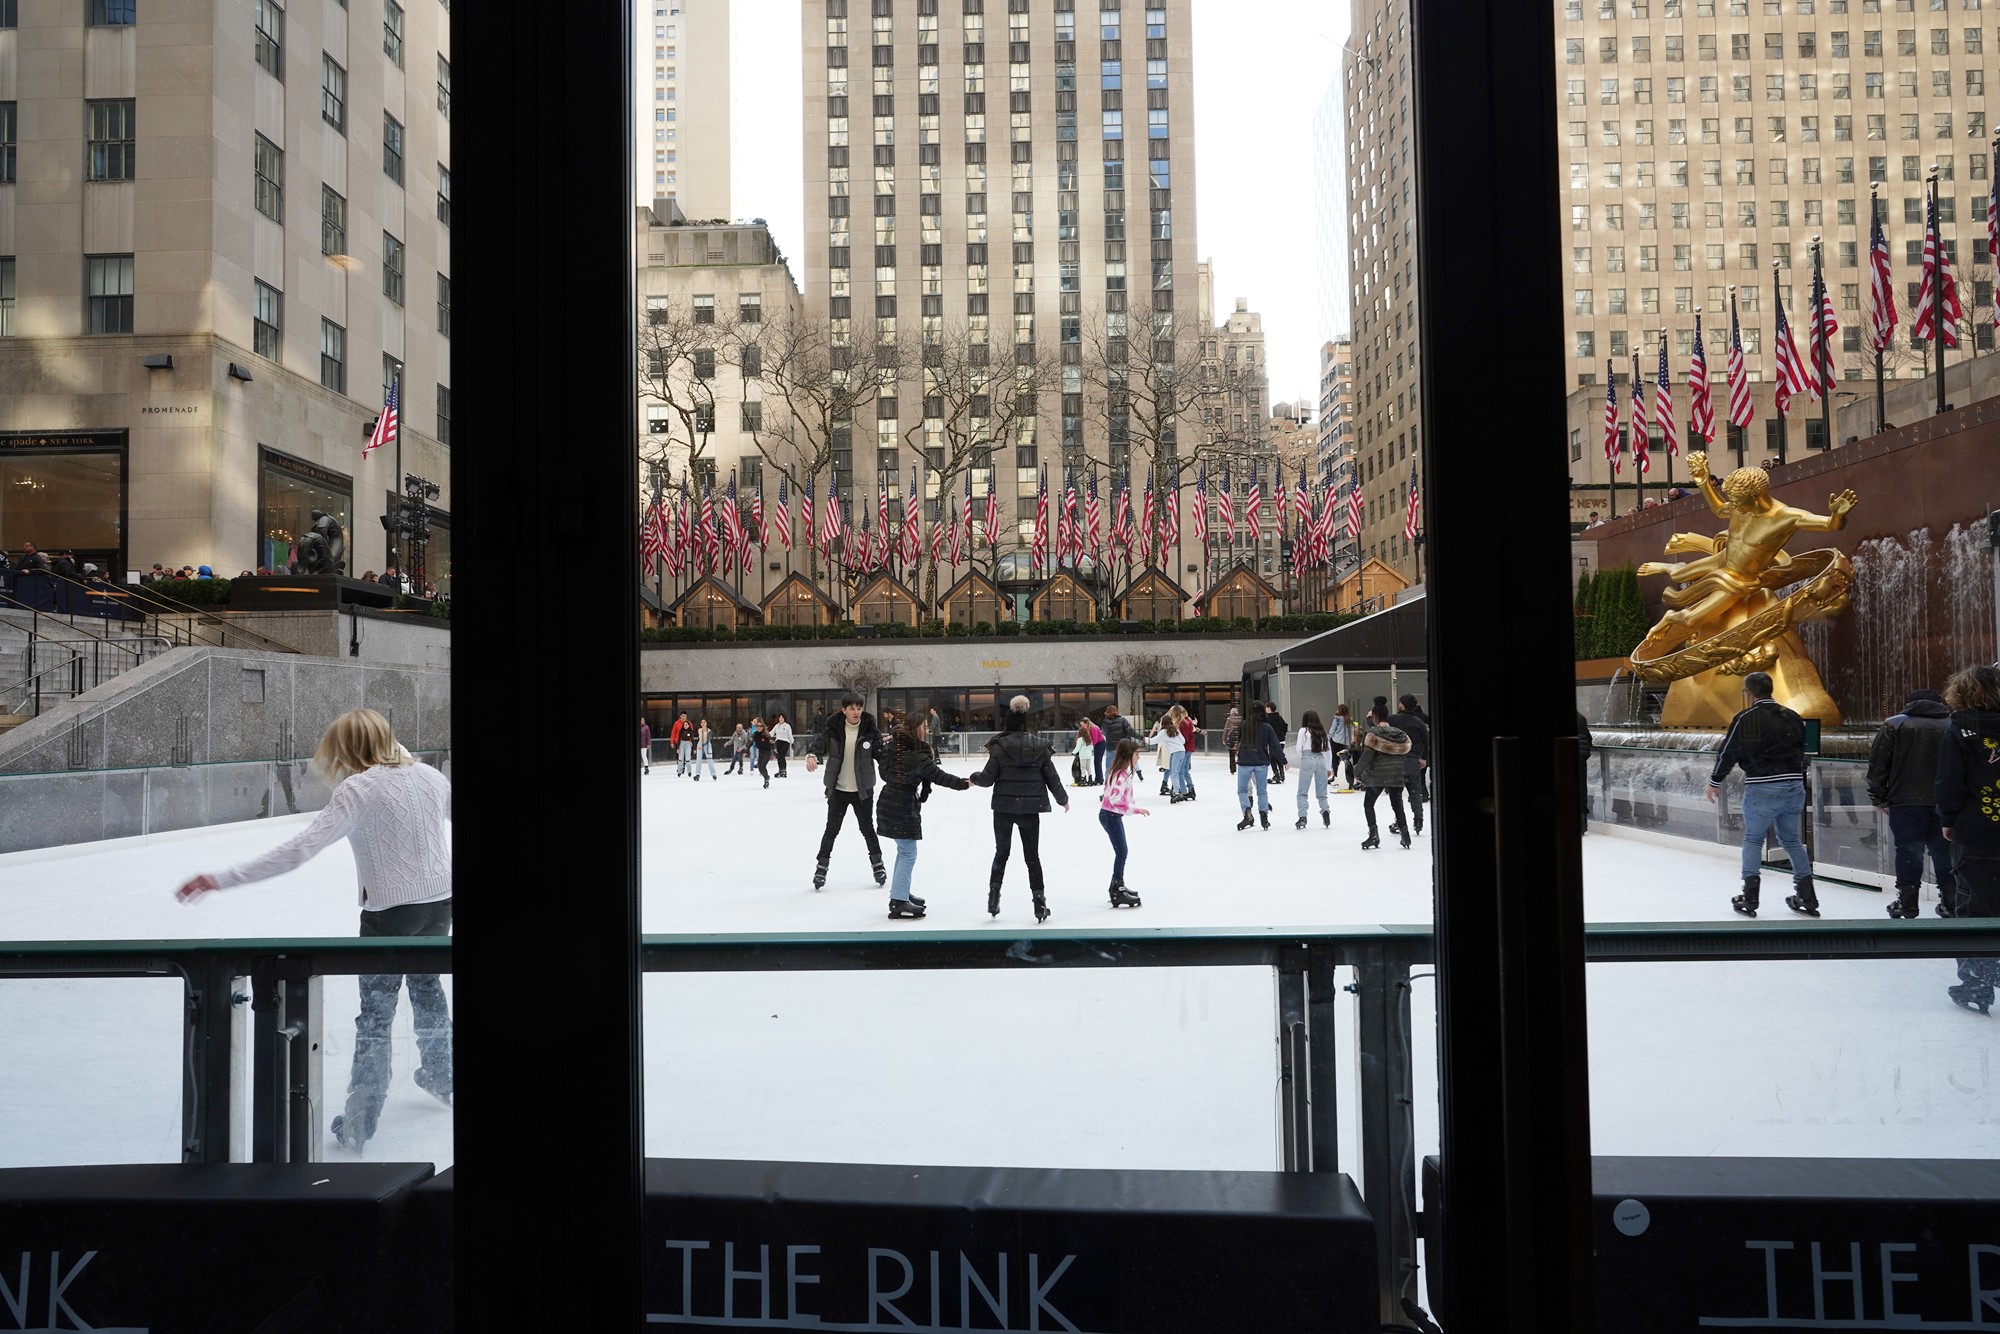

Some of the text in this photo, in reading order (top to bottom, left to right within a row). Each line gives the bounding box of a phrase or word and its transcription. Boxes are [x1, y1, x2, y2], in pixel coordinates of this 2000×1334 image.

[142, 406, 199, 414] PROMENADE
[9, 437, 37, 448] spade
[1577, 498, 1608, 509] NEWS
[666, 1240, 1080, 1331] THE RINK
[1745, 1240, 1921, 1322] THE
